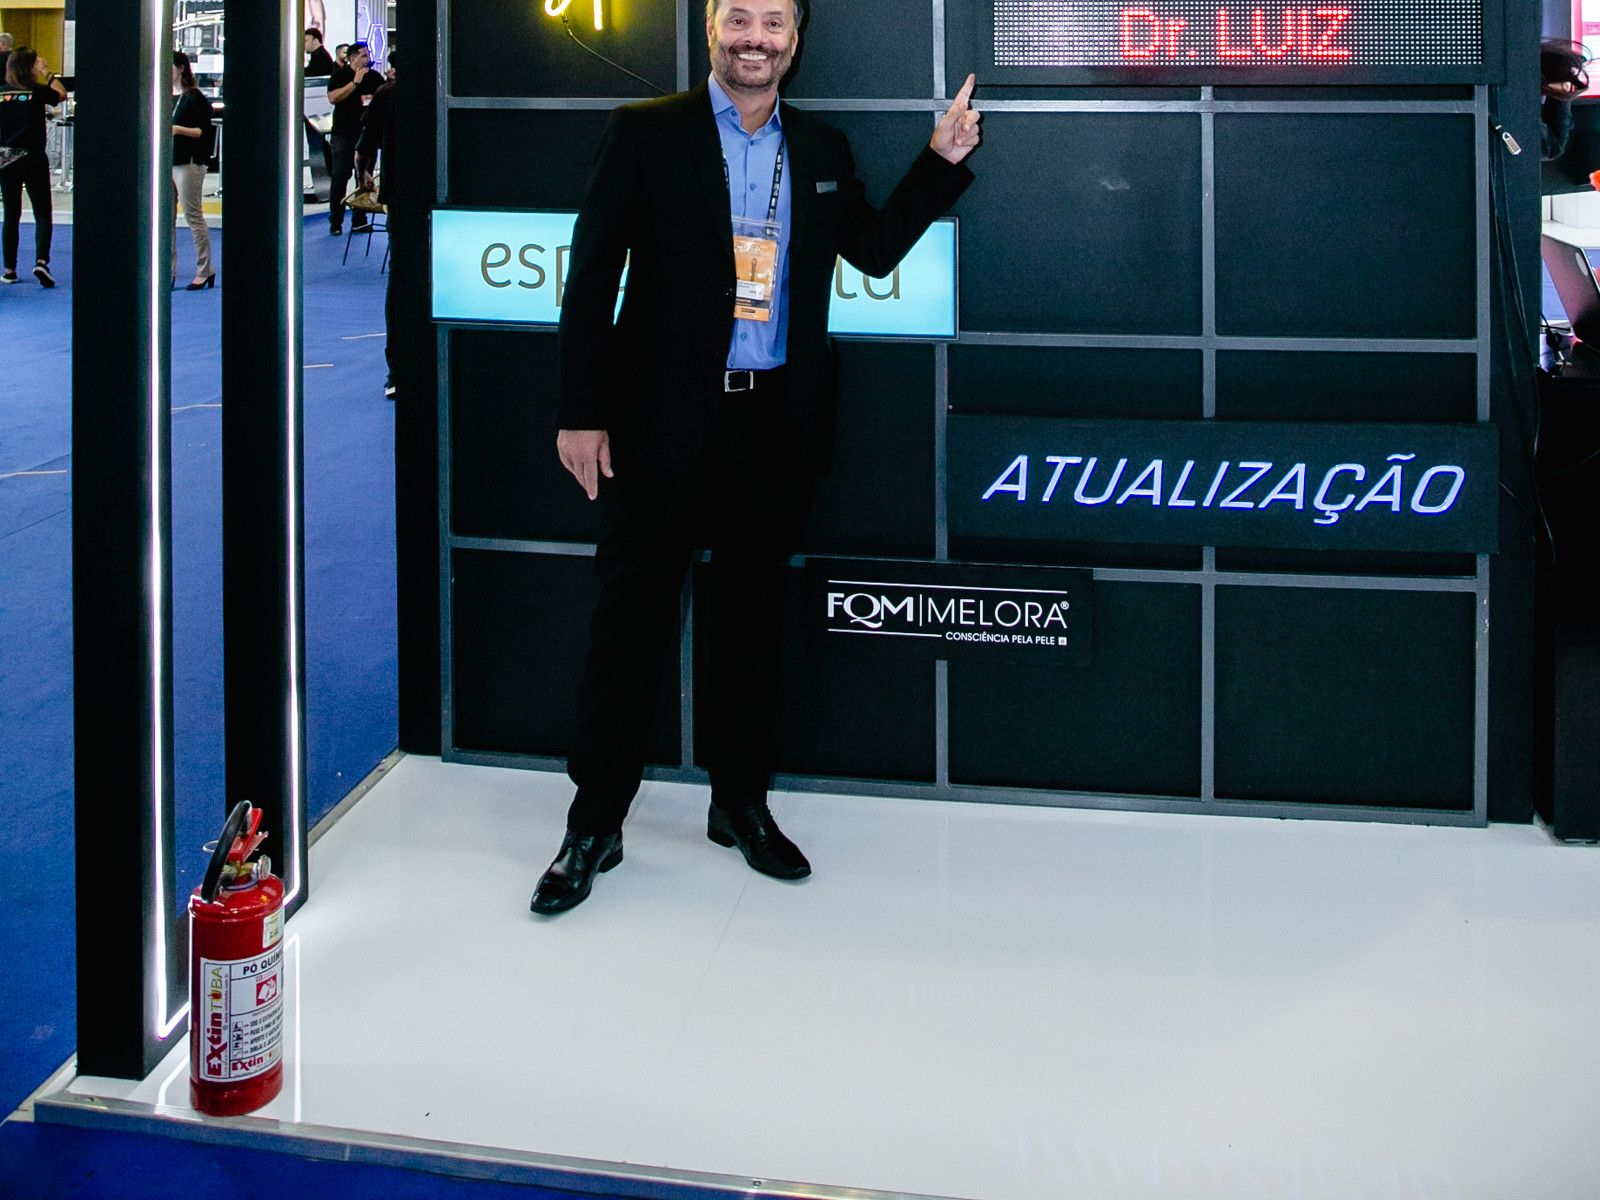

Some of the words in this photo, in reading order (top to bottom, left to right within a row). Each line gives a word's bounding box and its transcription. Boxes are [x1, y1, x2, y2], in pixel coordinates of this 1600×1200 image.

[1120, 8, 1197, 59] Dr.
[1217, 8, 1352, 59] LUIZ
[981, 453, 1466, 525] ATUALIZAÇÃO
[945, 630, 1010, 644] CONSCIÊNCIA
[1011, 634, 1034, 645] PELA
[1035, 635, 1056, 646] PELE
